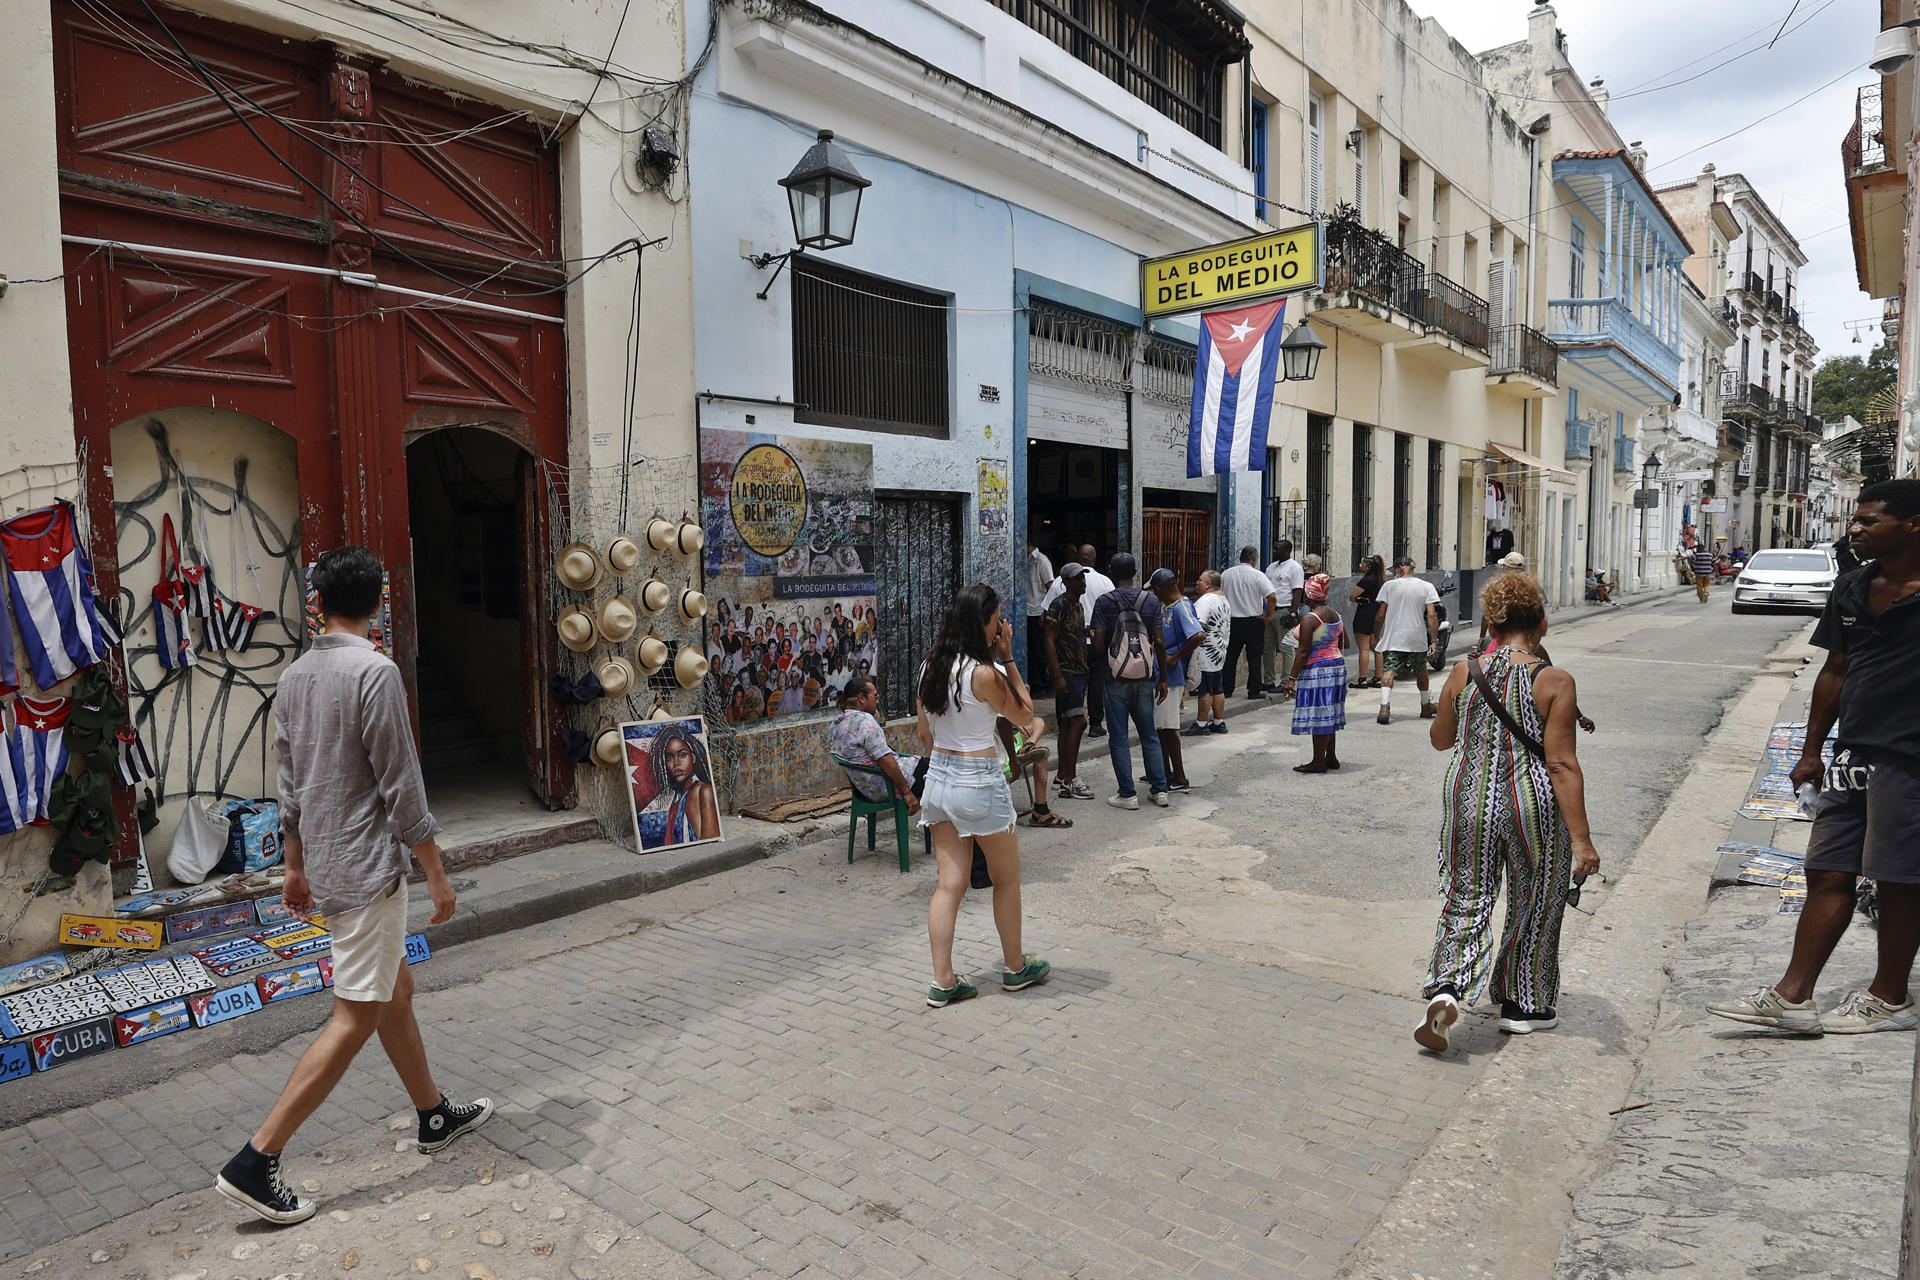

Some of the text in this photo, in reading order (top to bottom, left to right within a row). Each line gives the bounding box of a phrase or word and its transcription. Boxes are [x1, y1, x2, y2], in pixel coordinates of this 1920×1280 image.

[1158, 241, 1298, 281] LA BODEGUITA
[1158, 261, 1299, 304] DEL MEDIO
[736, 482, 802, 502] LA BODEGUITA
[744, 504, 763, 522] DEL
[782, 584, 793, 593] LA
[794, 583, 836, 593] BODEGUITA
[837, 583, 850, 592] DEL
[228, 956, 275, 971] Cuba
[126, 979, 213, 1007] P140293
[206, 991, 256, 1016] CUBA
[17, 1004, 112, 1033] K235361
[51, 1026, 108, 1058] CUBA
